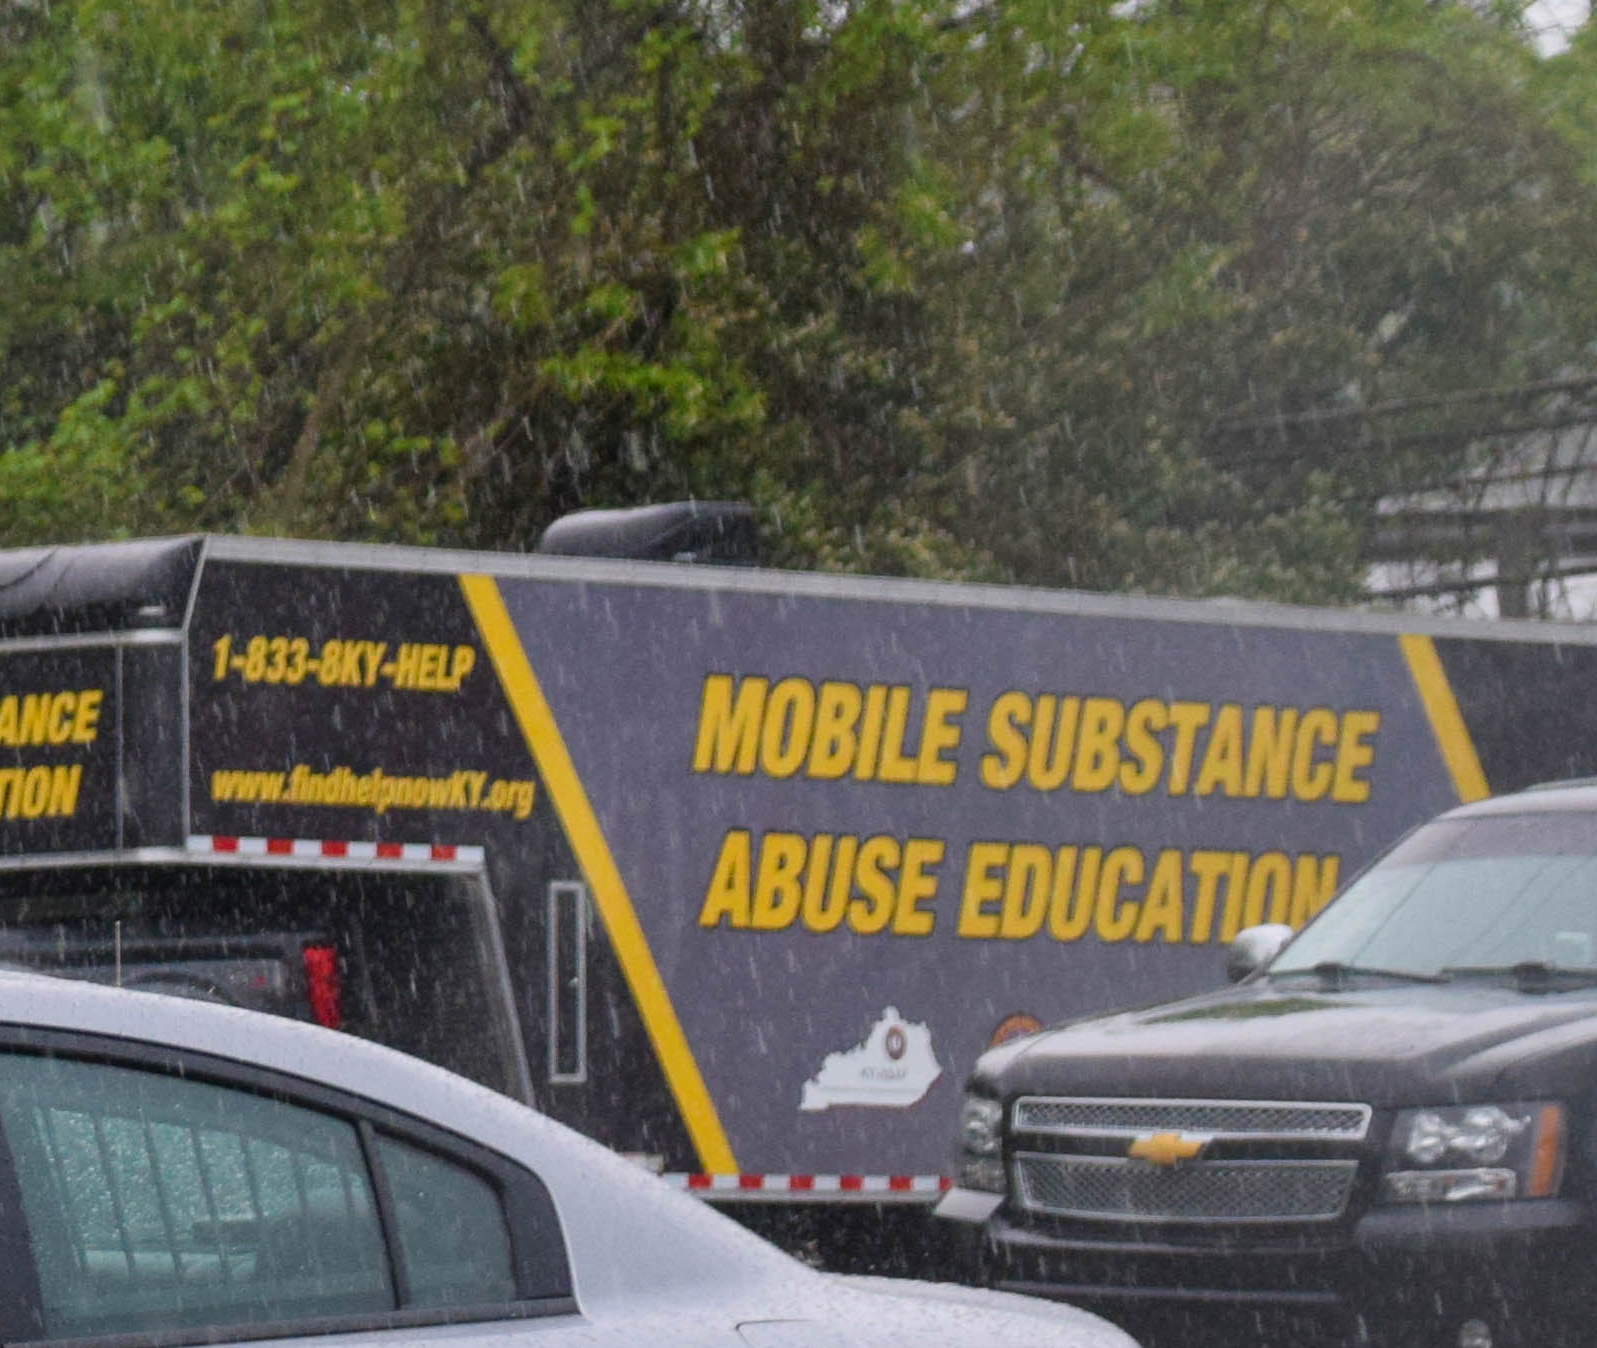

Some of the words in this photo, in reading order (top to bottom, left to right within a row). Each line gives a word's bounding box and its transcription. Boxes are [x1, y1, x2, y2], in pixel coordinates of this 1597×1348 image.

[212, 633, 477, 692] 1-833-8KY-HELP
[692, 674, 968, 787] MOBILE
[980, 691, 1380, 803] SUBSTANCE
[698, 830, 945, 937] ABUSE
[957, 842, 1340, 944] EDUCATION
